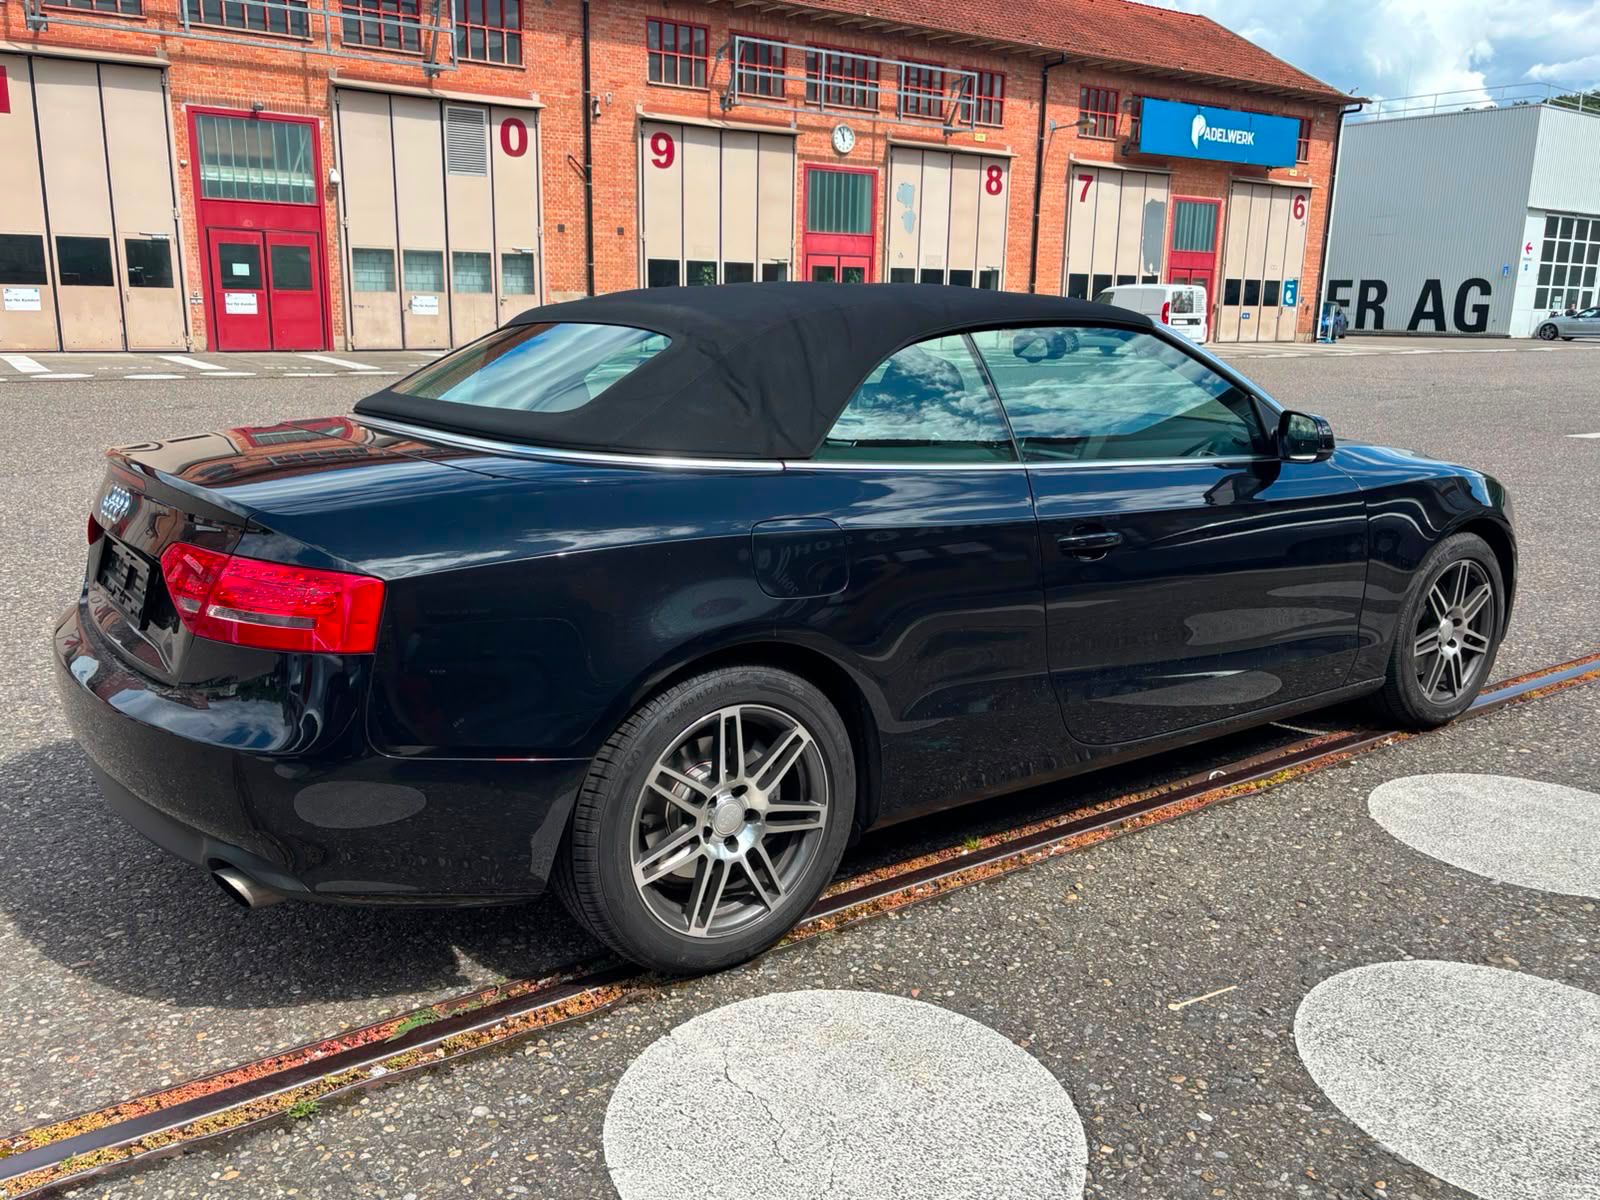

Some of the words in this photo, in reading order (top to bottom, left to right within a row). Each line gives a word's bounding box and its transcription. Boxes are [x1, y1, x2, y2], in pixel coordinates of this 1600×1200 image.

[500, 118, 528, 157] 0
[651, 132, 676, 169] 9
[985, 165, 1003, 196] 8
[1078, 174, 1093, 203] 7
[1293, 194, 1306, 220] 6
[1406, 277, 1493, 334] AG
